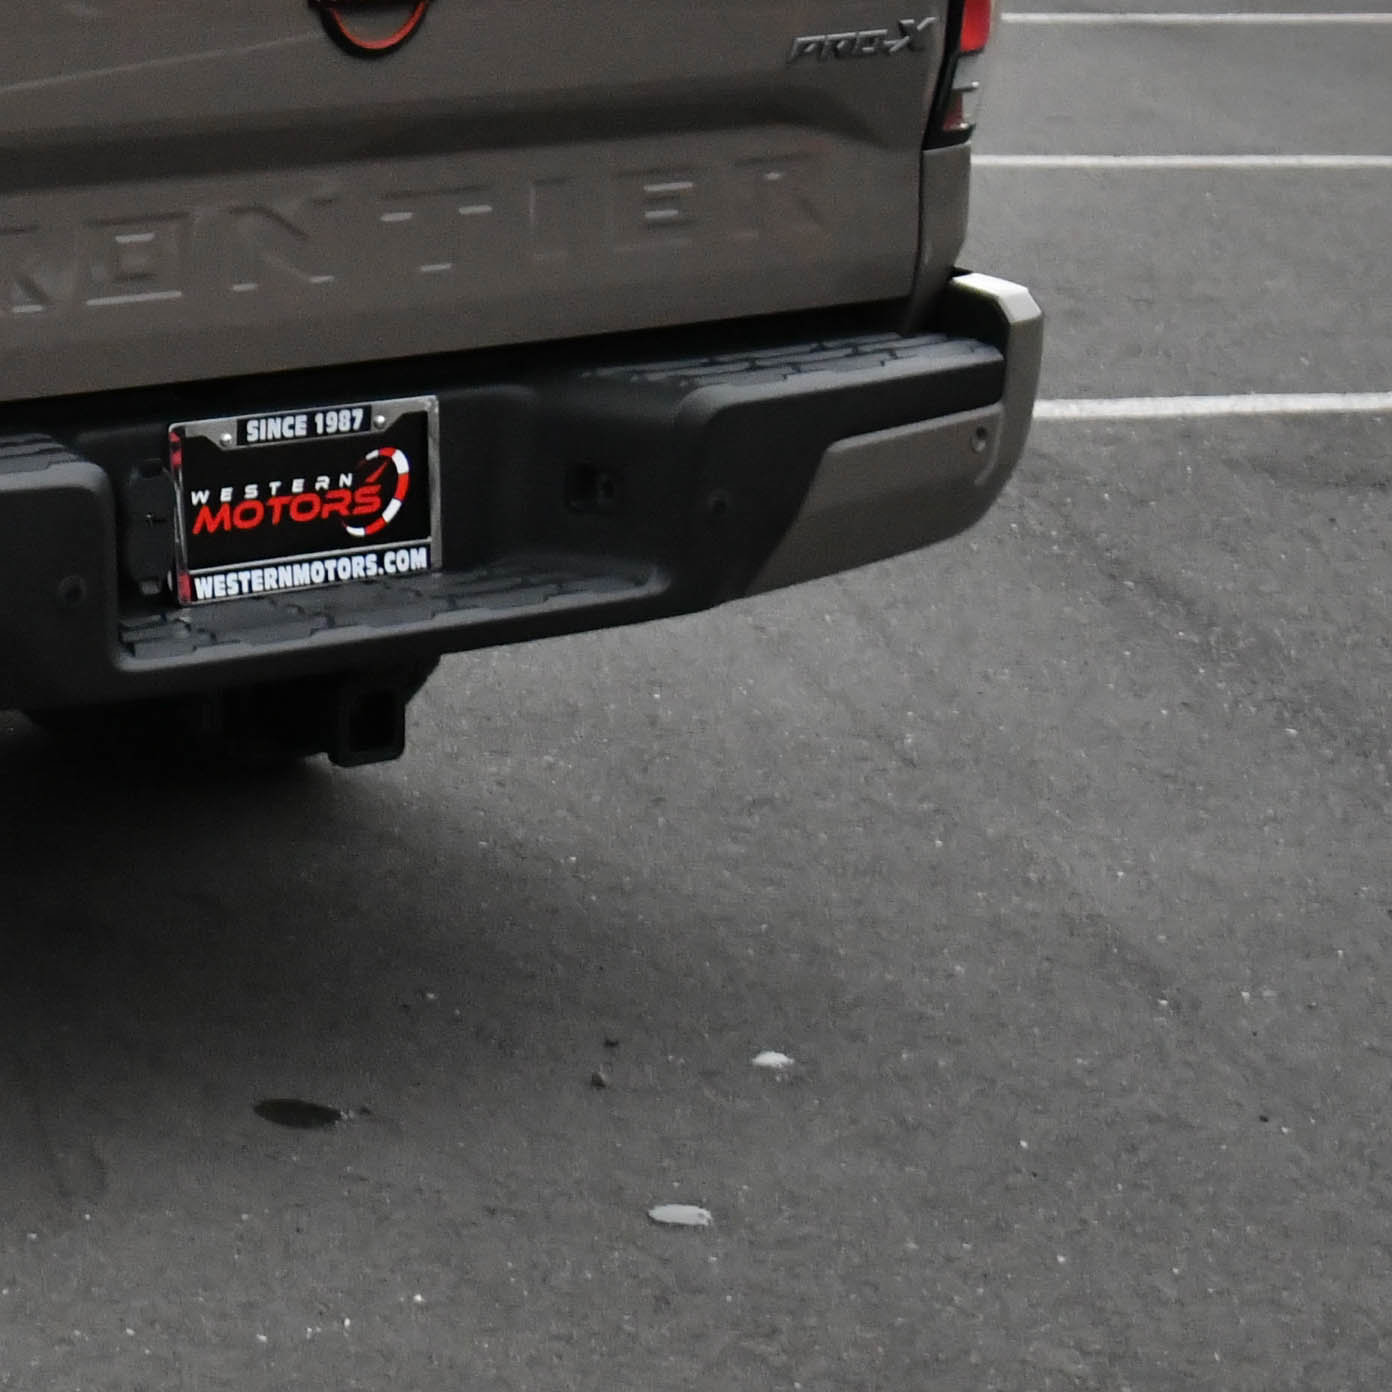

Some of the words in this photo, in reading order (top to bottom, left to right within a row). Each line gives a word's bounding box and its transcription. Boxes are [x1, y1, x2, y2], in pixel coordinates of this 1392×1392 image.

[246, 415, 307, 443] SINCE
[315, 409, 364, 436] 1987
[191, 472, 354, 506] WESTERN
[192, 484, 382, 536] MOTORS
[194, 547, 428, 600] WESTERNMOTORS.COM
